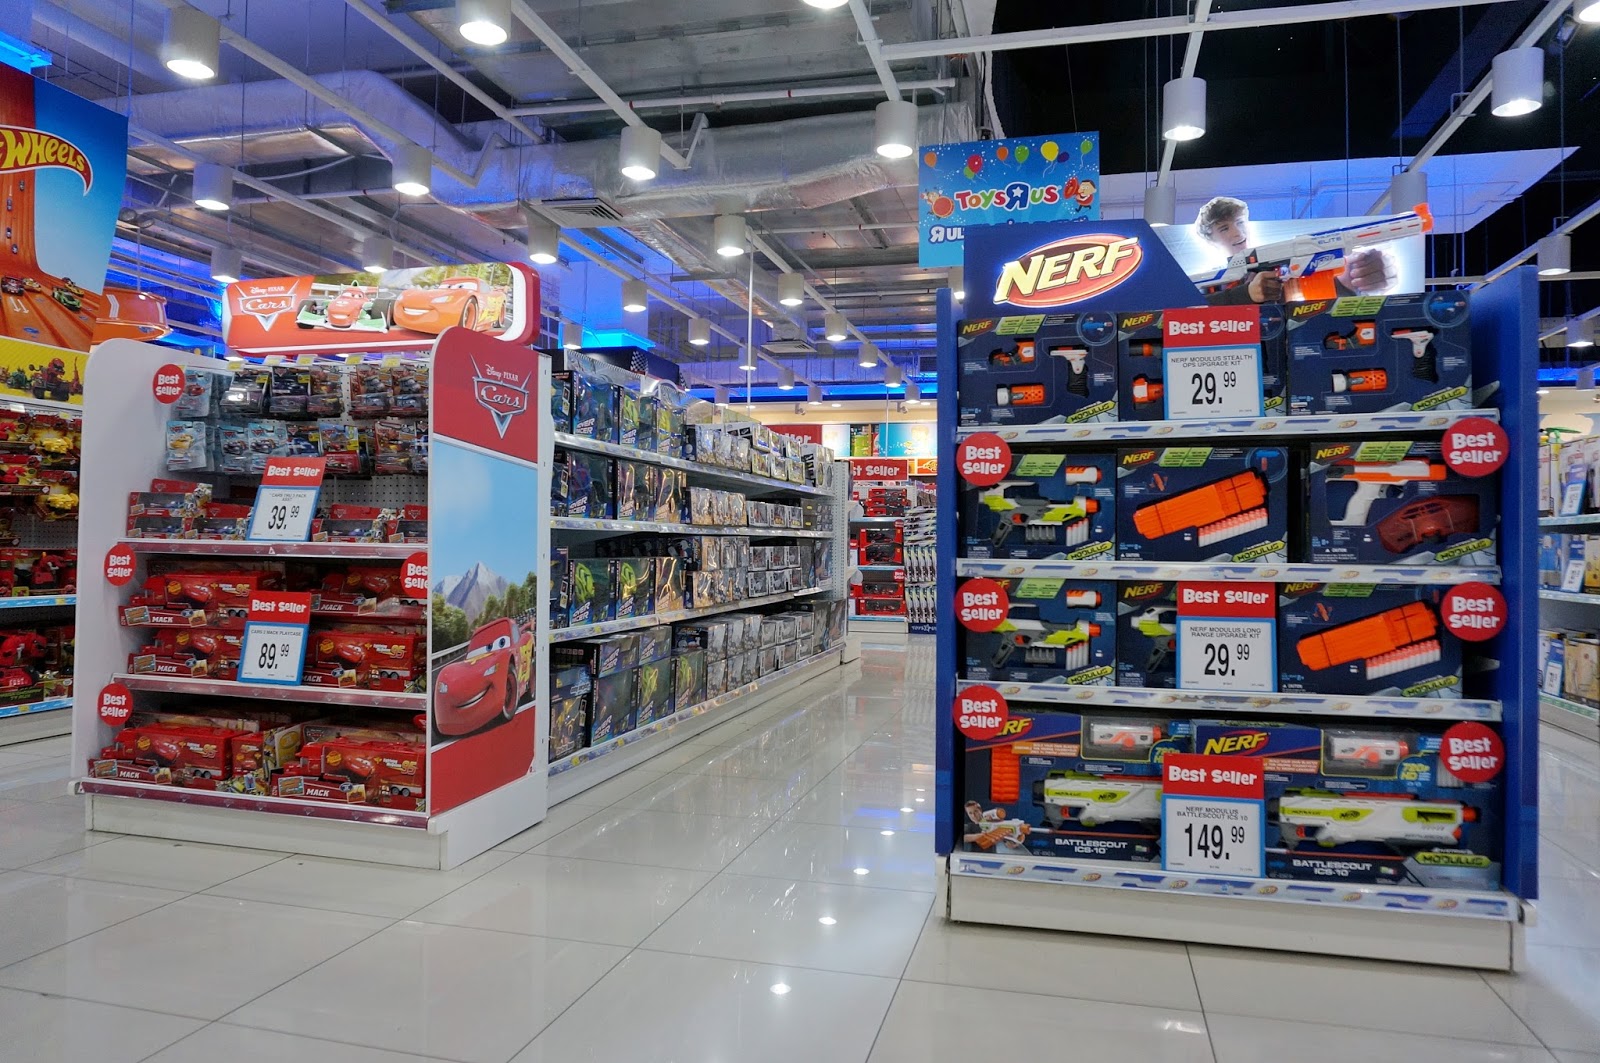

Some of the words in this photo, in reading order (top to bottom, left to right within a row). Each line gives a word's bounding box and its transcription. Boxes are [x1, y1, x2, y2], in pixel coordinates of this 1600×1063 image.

[993, 236, 1139, 304] NERF
[245, 299, 289, 310] Cars
[1293, 301, 1327, 317] NERF
[962, 319, 992, 334] NERF
[1122, 314, 1153, 328] NERF
[1168, 320, 1205, 335] Best
[1208, 319, 1254, 333] Seller
[157, 374, 180, 385] Best
[1223, 371, 1237, 388] 99
[155, 386, 182, 396] Seller
[480, 385, 521, 408] Cars
[1070, 402, 1110, 421] MODULUS
[1451, 432, 1496, 449] Best
[965, 445, 1002, 461] Best
[1123, 451, 1155, 465] NERF
[1316, 445, 1350, 460] NERF
[1449, 449, 1502, 465] Seller
[267, 465, 291, 476] Best
[293, 466, 321, 477] Seller
[852, 465, 862, 475] st
[866, 464, 900, 476] Seller
[962, 461, 1006, 475] Seller
[290, 505, 300, 518] 99
[1070, 544, 1108, 560] MODULUS
[1237, 543, 1279, 561] MODULUS
[109, 554, 131, 566] Best
[107, 566, 133, 578] Seller
[407, 563, 428, 576] Bes
[404, 577, 428, 589] Selle
[1124, 583, 1163, 598] NERF
[962, 592, 999, 607] Best
[1183, 589, 1220, 604] Best
[1224, 590, 1270, 605] Seller
[1451, 596, 1495, 612] Best
[252, 599, 276, 612] Best
[278, 601, 307, 613] Seller
[961, 608, 1004, 621] Seller
[1448, 614, 1500, 629] Seller
[280, 643, 290, 657] 99
[1237, 643, 1250, 660] 99
[157, 665, 177, 673] MACK
[1070, 668, 1108, 684] MODULUS
[103, 693, 127, 706] Best
[962, 699, 998, 714] Best
[101, 706, 129, 718] Seller
[959, 715, 1002, 729] Seller
[1000, 717, 1032, 736] RF
[1203, 732, 1268, 755] NERF
[1448, 738, 1492, 754] Best
[401, 760, 418, 775] 95
[1448, 755, 1498, 770] Seller
[119, 770, 140, 779] MACK
[1168, 765, 1207, 782] Best
[1211, 769, 1258, 785] Seller
[306, 788, 329, 797] MACK
[1177, 811, 1225, 820] BATTLESCOUT
[1231, 826, 1245, 843] 99
[1055, 838, 1128, 849] BATTLESCOUT
[1292, 859, 1373, 871] BATTLESCOUT
[1423, 854, 1484, 866] MODULUS
